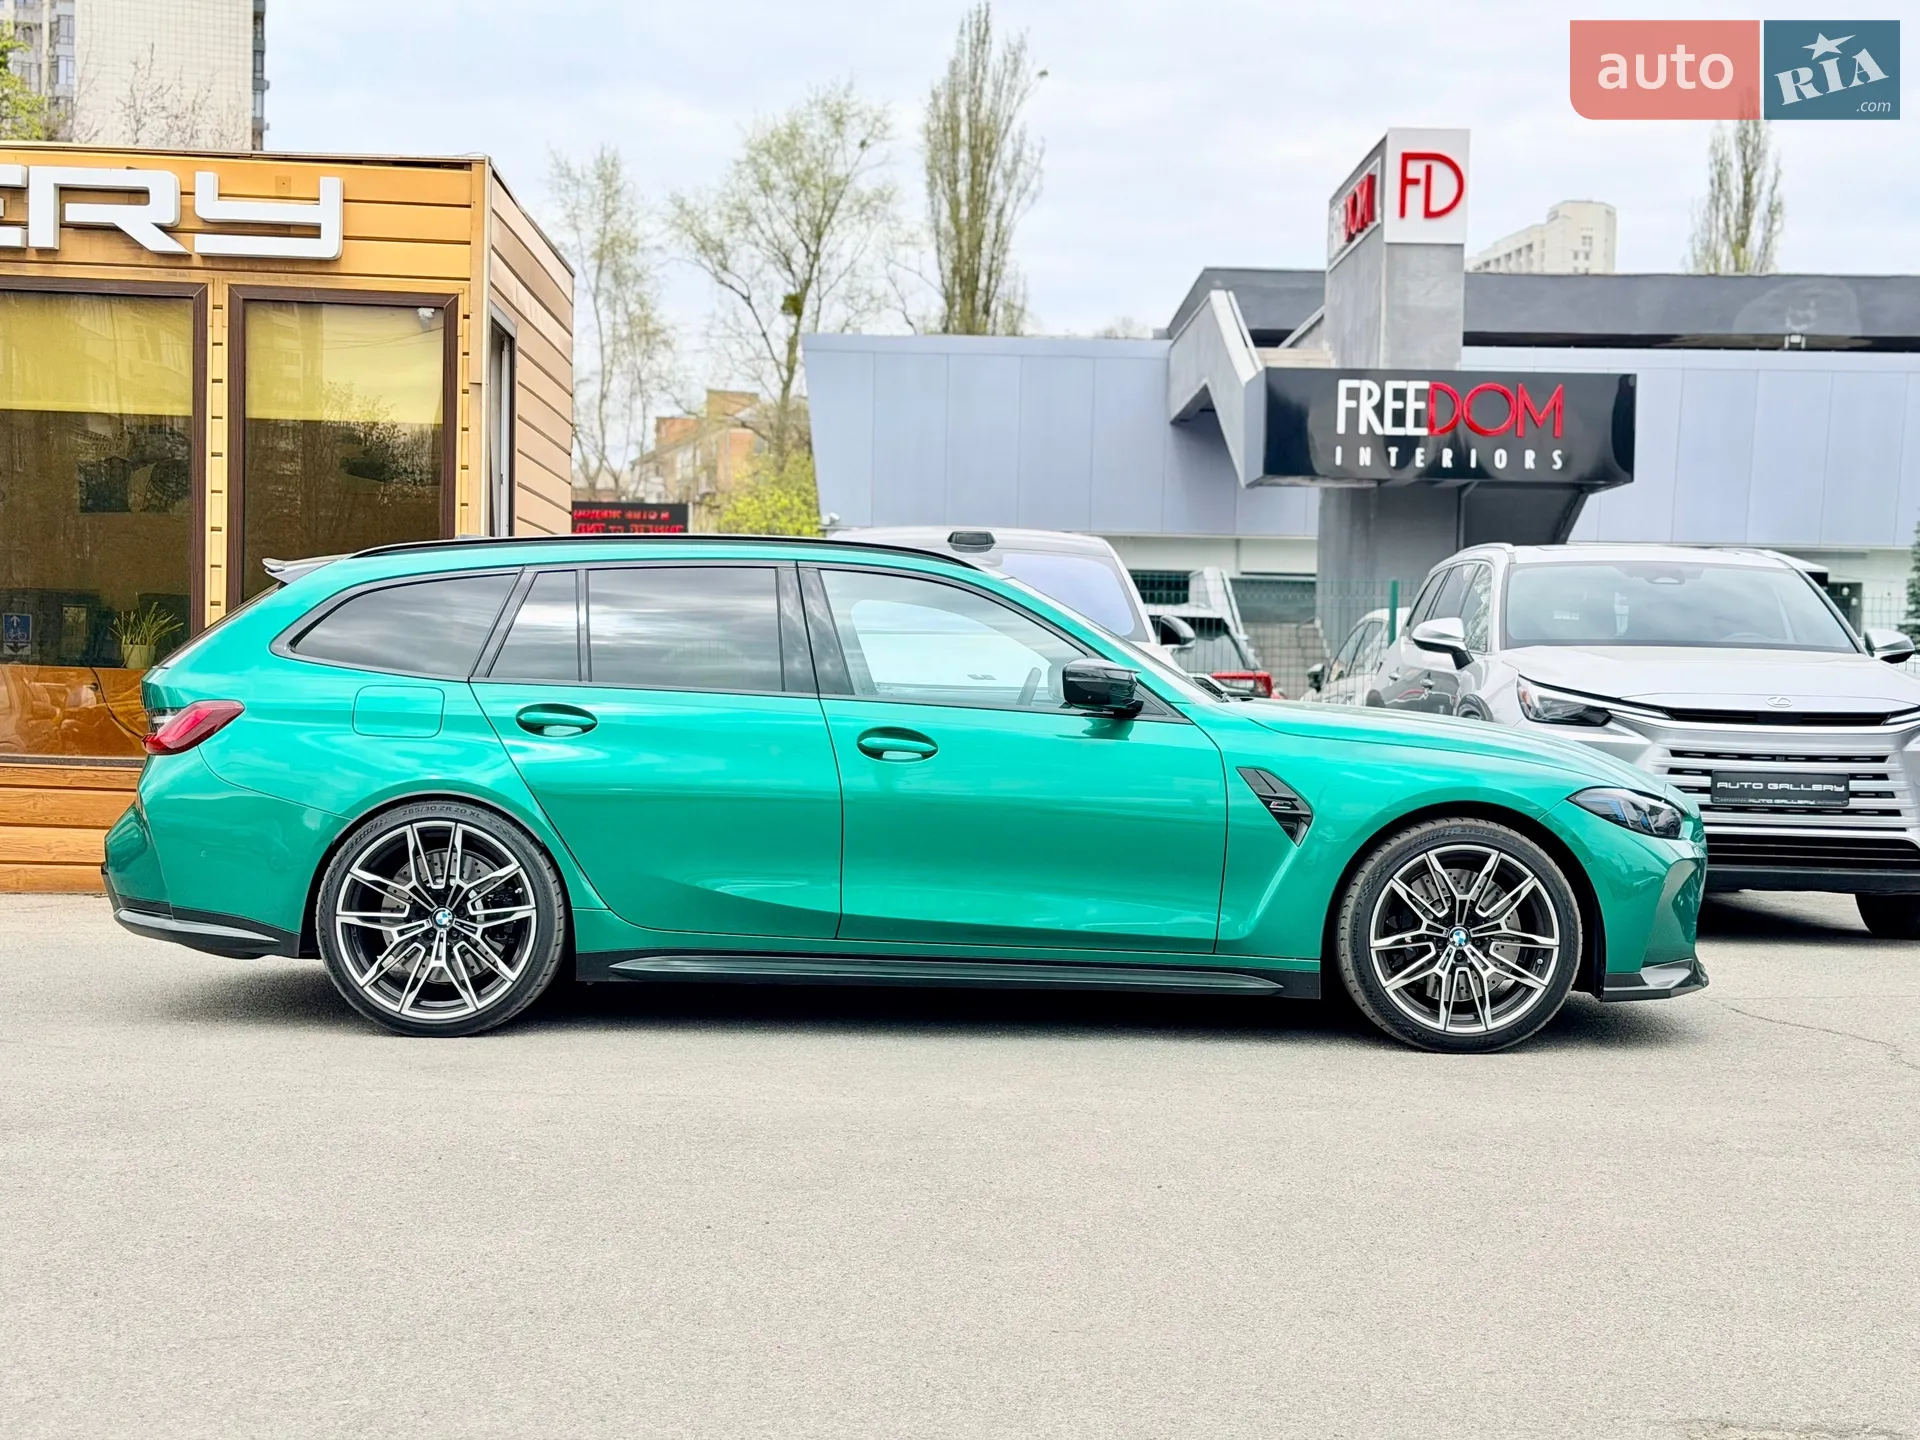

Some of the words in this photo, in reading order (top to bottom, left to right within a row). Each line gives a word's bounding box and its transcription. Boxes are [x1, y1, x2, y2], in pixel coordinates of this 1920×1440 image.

[1398, 151, 1465, 220] FD
[0, 164, 343, 260] RY
[1336, 378, 1565, 440] FREEDOM
[1334, 445, 1564, 471] INTERIORS
[1716, 781, 1764, 790] AUTO
[1767, 782, 1845, 792] GALLERY
[402, 806, 437, 816] 285/30
[469, 810, 482, 819] XL
